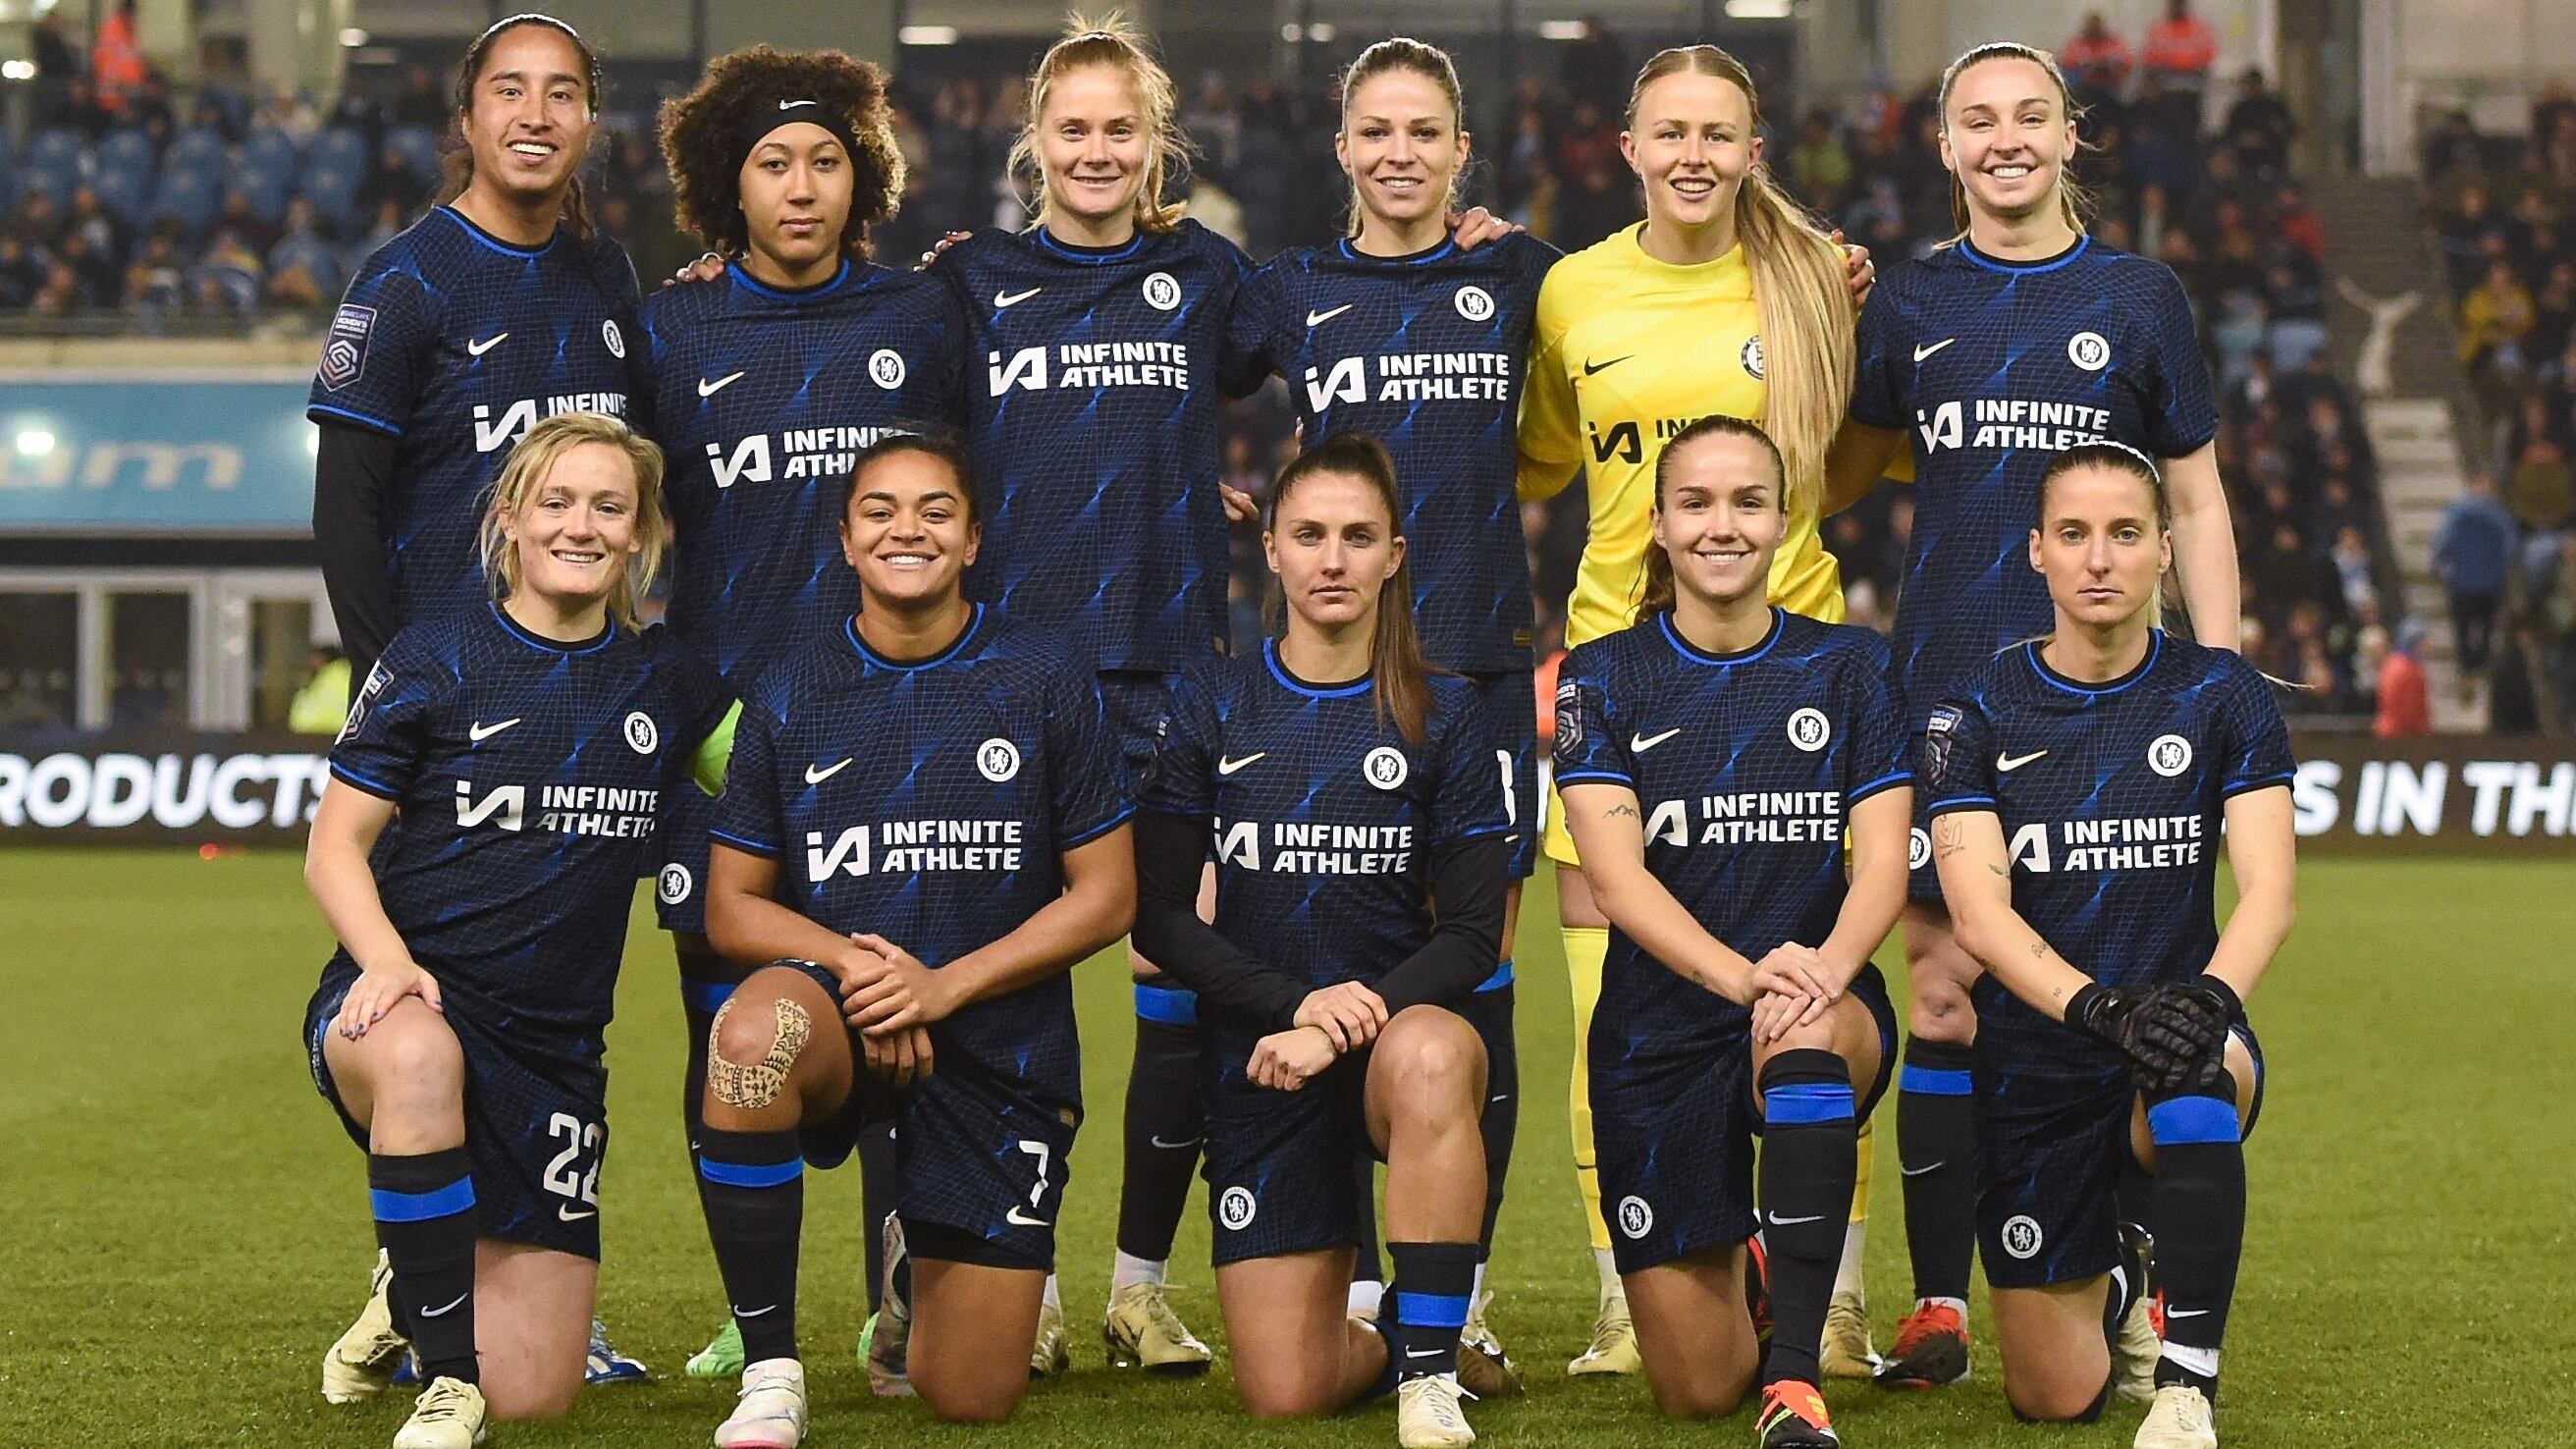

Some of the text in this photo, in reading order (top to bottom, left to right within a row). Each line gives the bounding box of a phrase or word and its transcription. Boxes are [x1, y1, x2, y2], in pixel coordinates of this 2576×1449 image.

[1060, 342, 1189, 366] INFINITE
[1378, 352, 1510, 377] INFINITE
[1059, 364, 1189, 391] ATHLETE
[1378, 377, 1510, 402] ATHLETE
[1975, 399, 2111, 431] INFINITE
[783, 427, 908, 454] INFINI
[541, 784, 659, 814] INFINITE
[1701, 791, 1841, 820] INFINITE
[2354, 760, 2448, 836] IN
[2462, 760, 2576, 836] TH
[535, 811, 656, 838] ATHLETE
[883, 820, 1023, 845] INFINITE
[1274, 823, 1414, 850] INFINITE
[1700, 818, 1840, 845] ATHLETE
[2064, 814, 2203, 845] INFINITE
[881, 847, 1023, 873] ATHLETE
[1272, 850, 1412, 876] ATHLETE
[2064, 840, 2203, 872] ATHLETE
[543, 1111, 604, 1209] 22
[1018, 1140, 1049, 1209] 7
